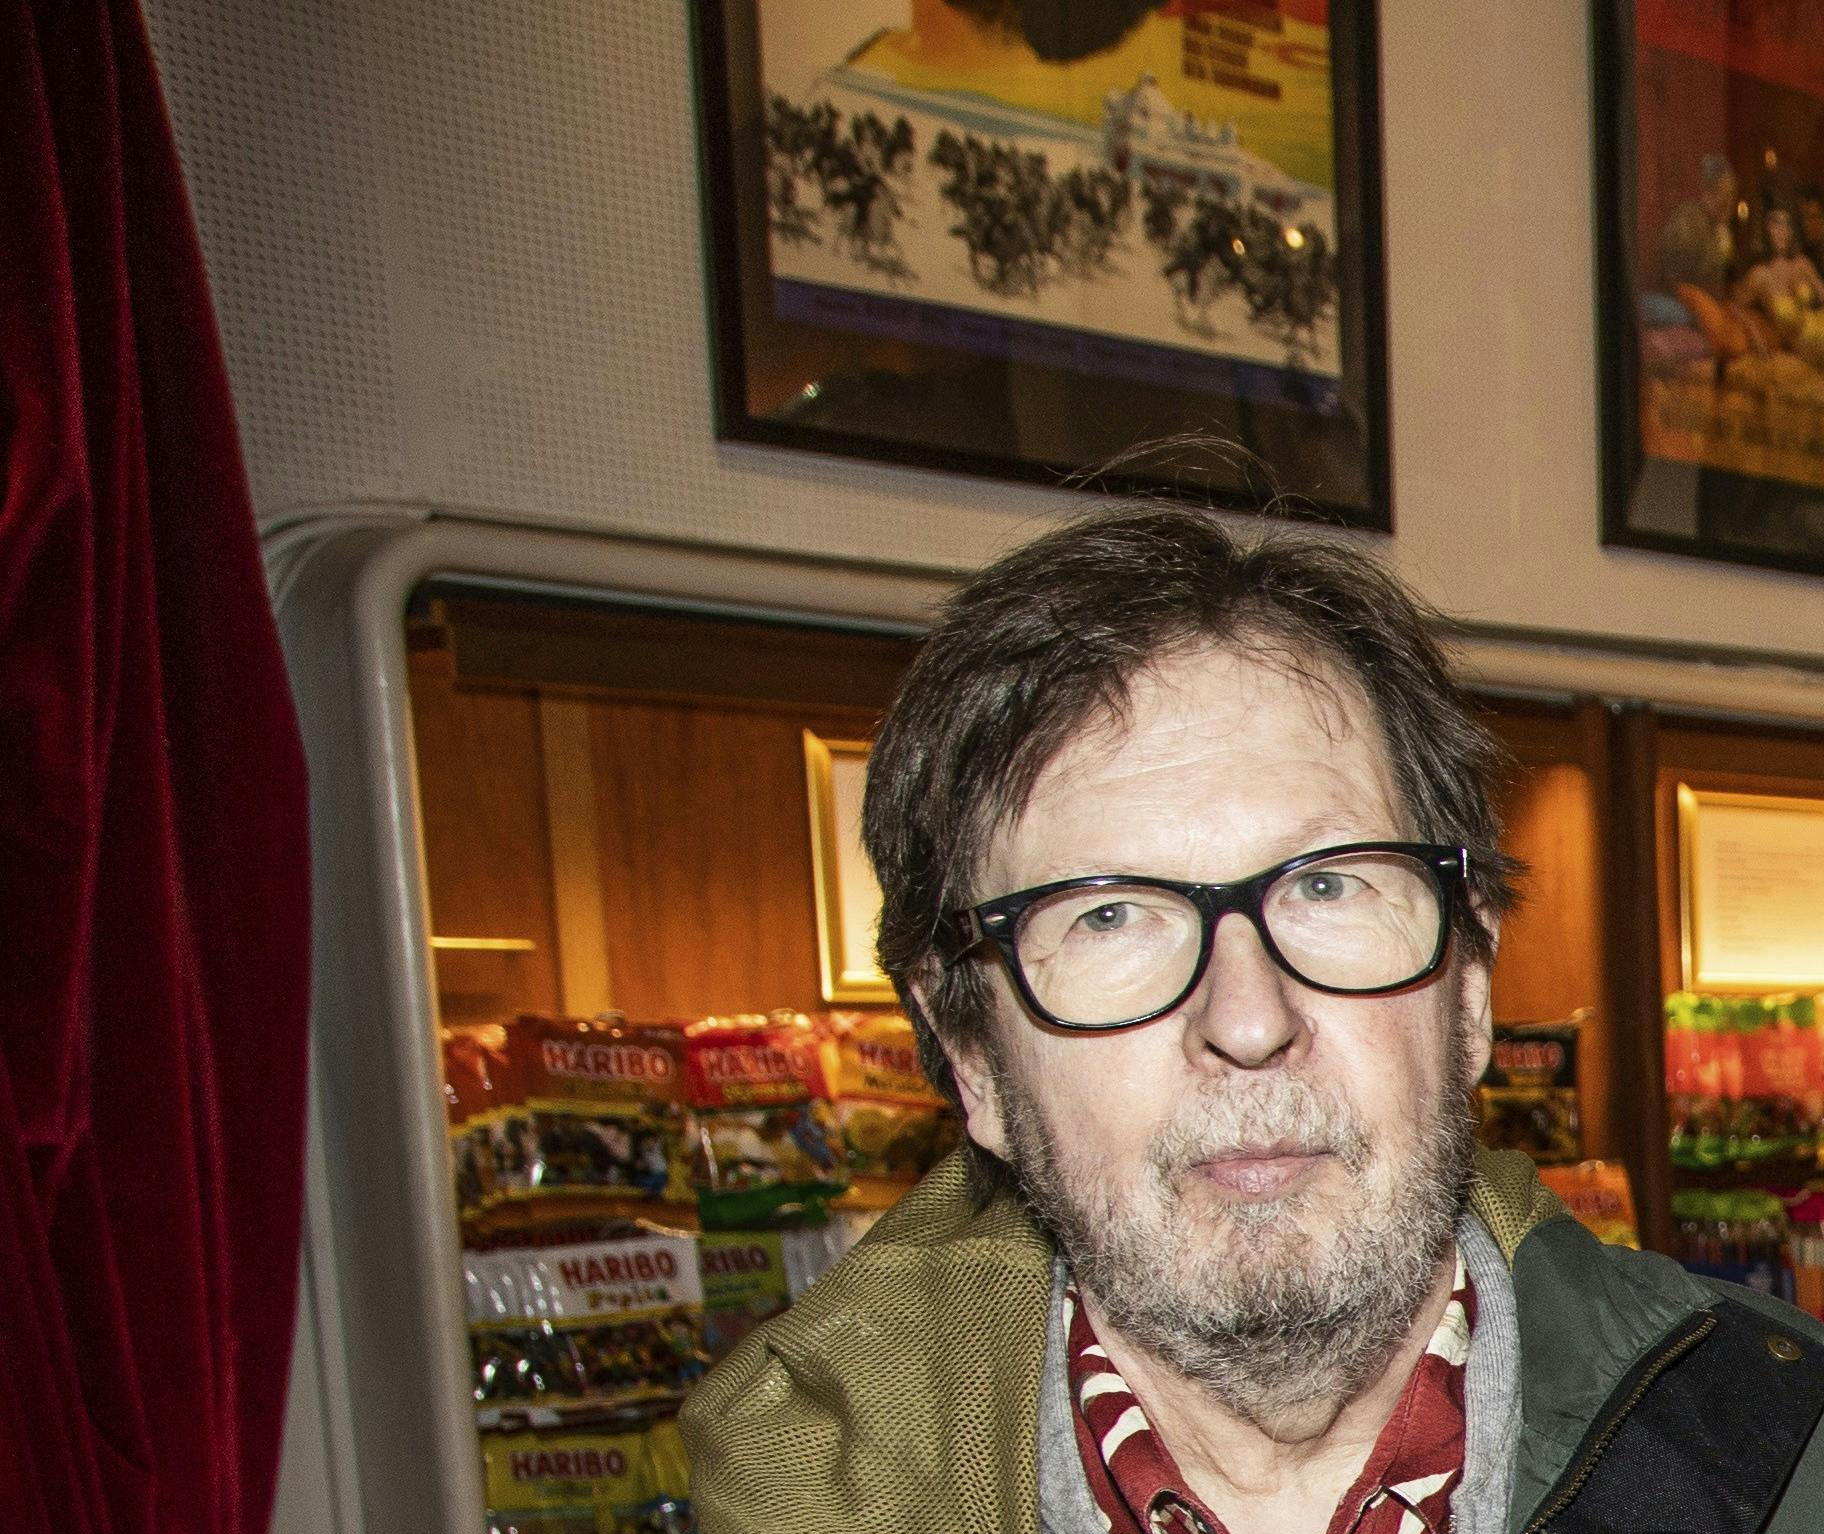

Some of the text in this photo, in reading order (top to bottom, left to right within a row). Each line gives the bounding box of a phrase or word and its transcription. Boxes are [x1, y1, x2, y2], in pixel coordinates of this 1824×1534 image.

[543, 1040, 676, 1083] HARIBO
[559, 1249, 678, 1291] HARIBO
[509, 1446, 628, 1482] HARIBO
